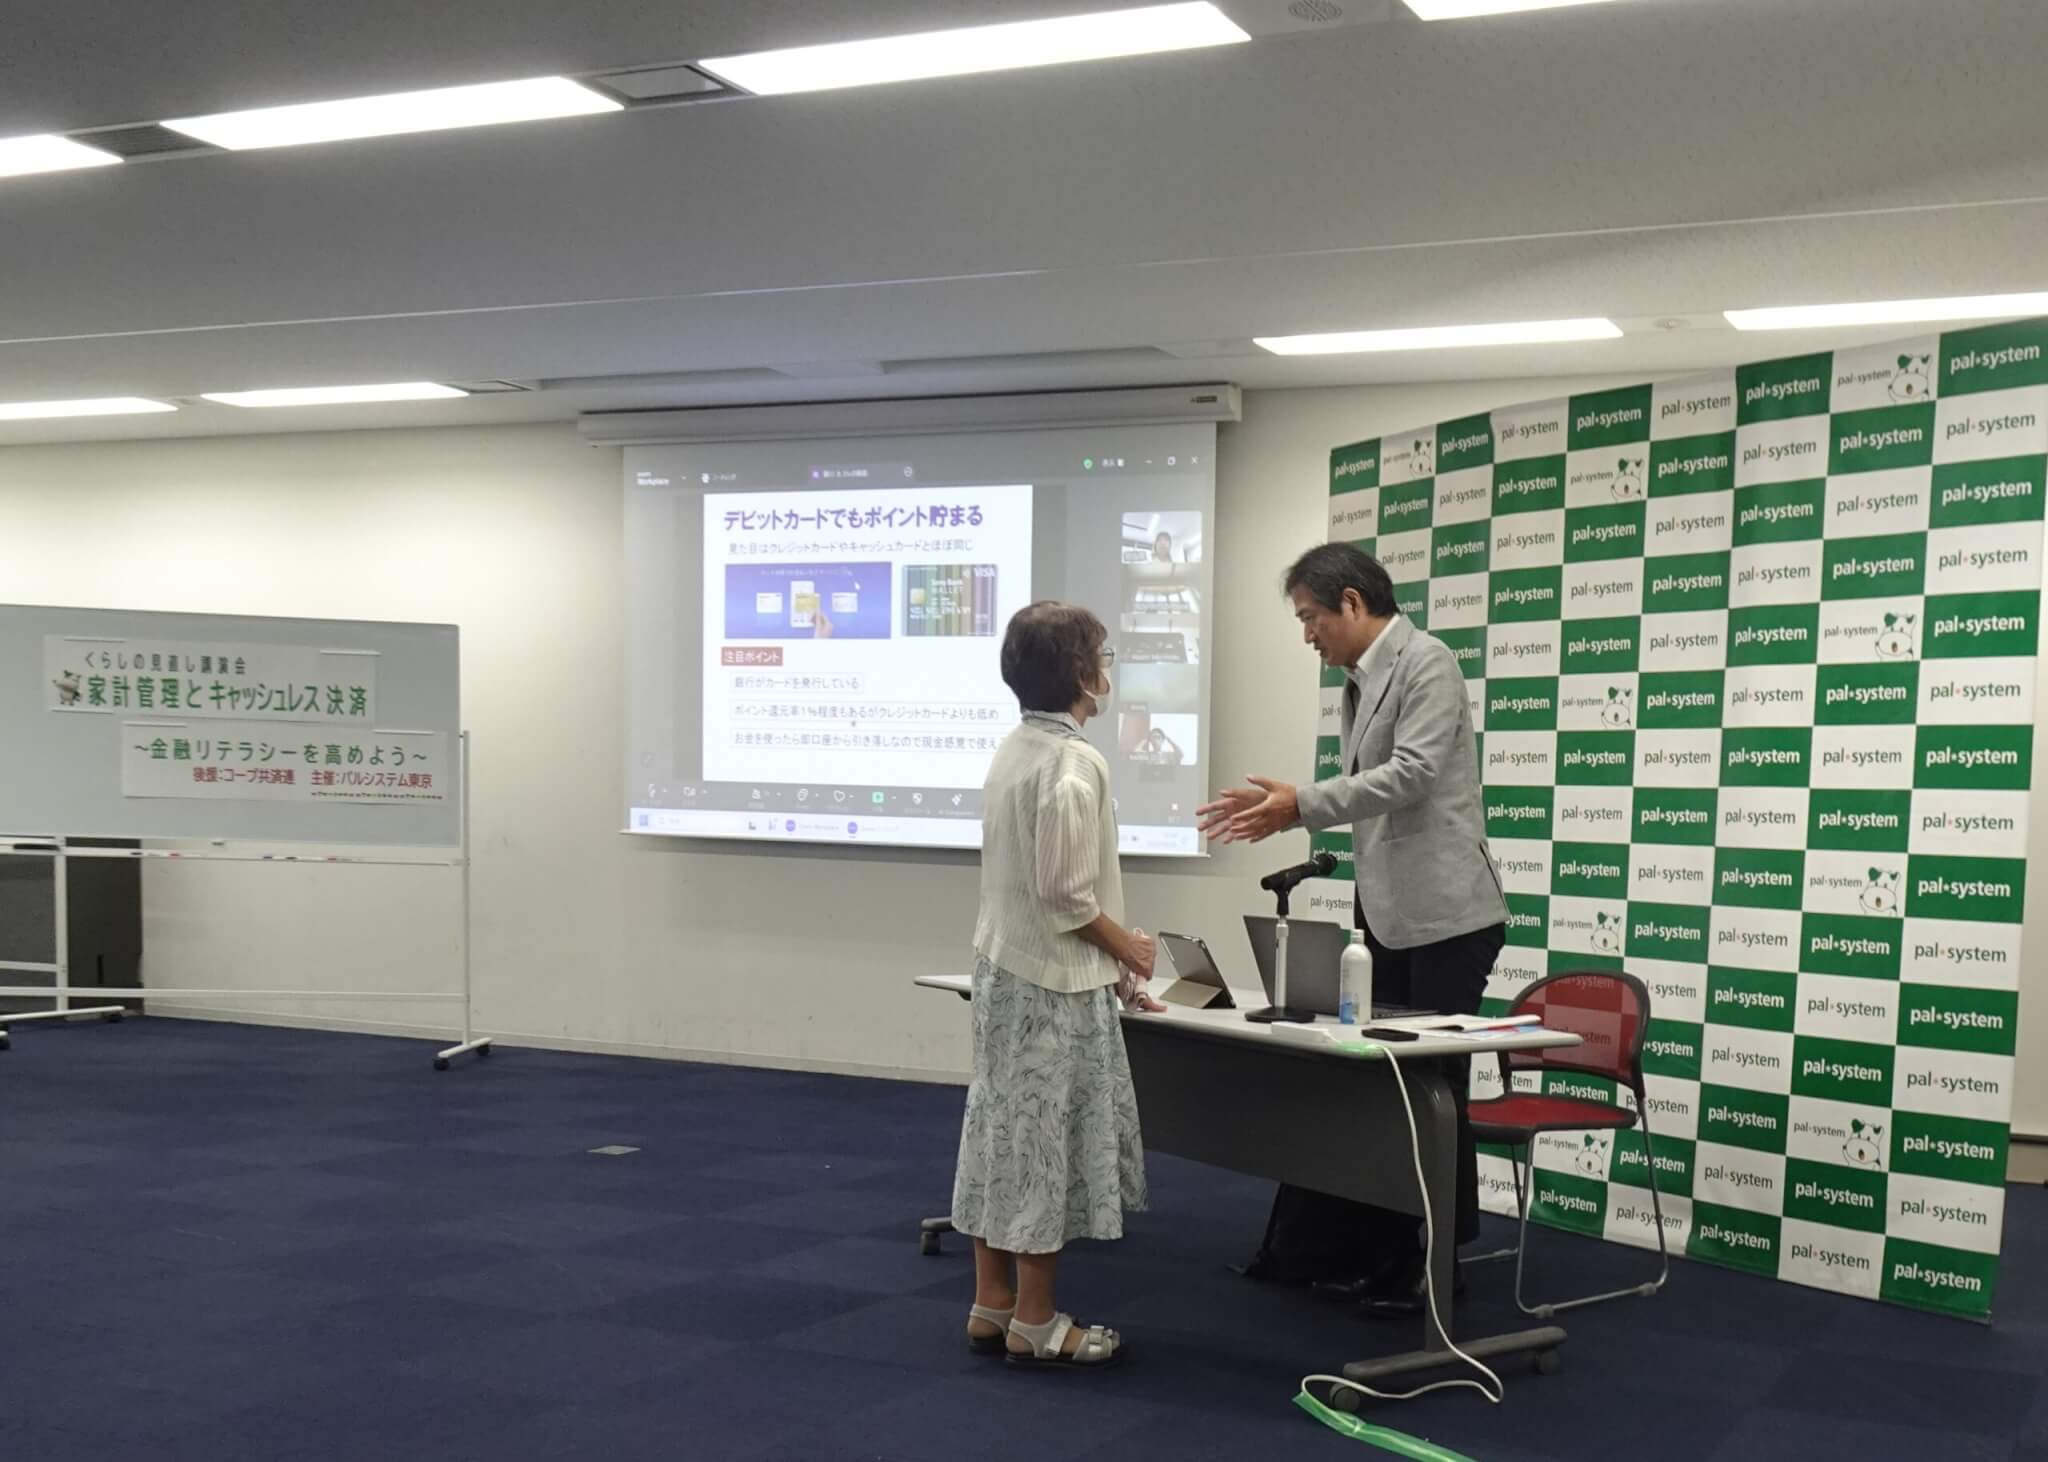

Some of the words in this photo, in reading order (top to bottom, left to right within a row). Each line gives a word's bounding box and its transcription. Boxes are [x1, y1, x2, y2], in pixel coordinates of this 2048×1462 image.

[724, 504, 984, 531] デビットカードでもポイント貯まる
[84, 651, 247, 675] くらしの見直し講演会
[724, 651, 780, 663] 注目ポイント
[86, 675, 368, 717] 家計管理とキャッシュレス決済
